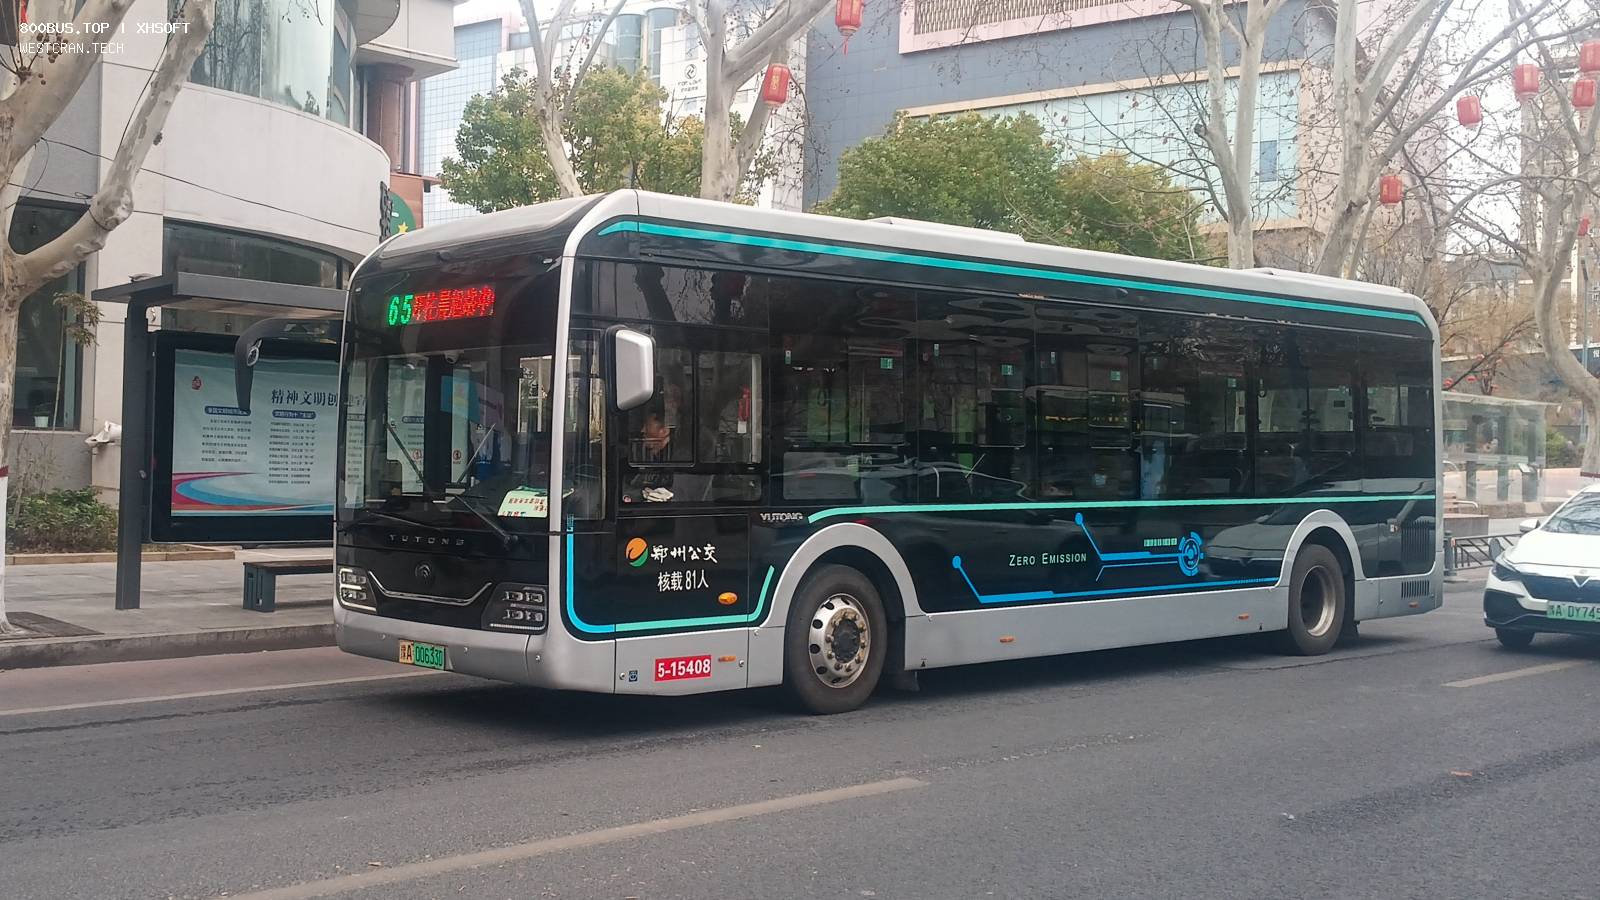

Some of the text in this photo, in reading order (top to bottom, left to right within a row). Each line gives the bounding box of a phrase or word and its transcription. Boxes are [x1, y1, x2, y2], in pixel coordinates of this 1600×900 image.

[388, 295, 413, 326] 65
[651, 543, 717, 564] 郑州公交
[658, 659, 711, 677] 5-15408
